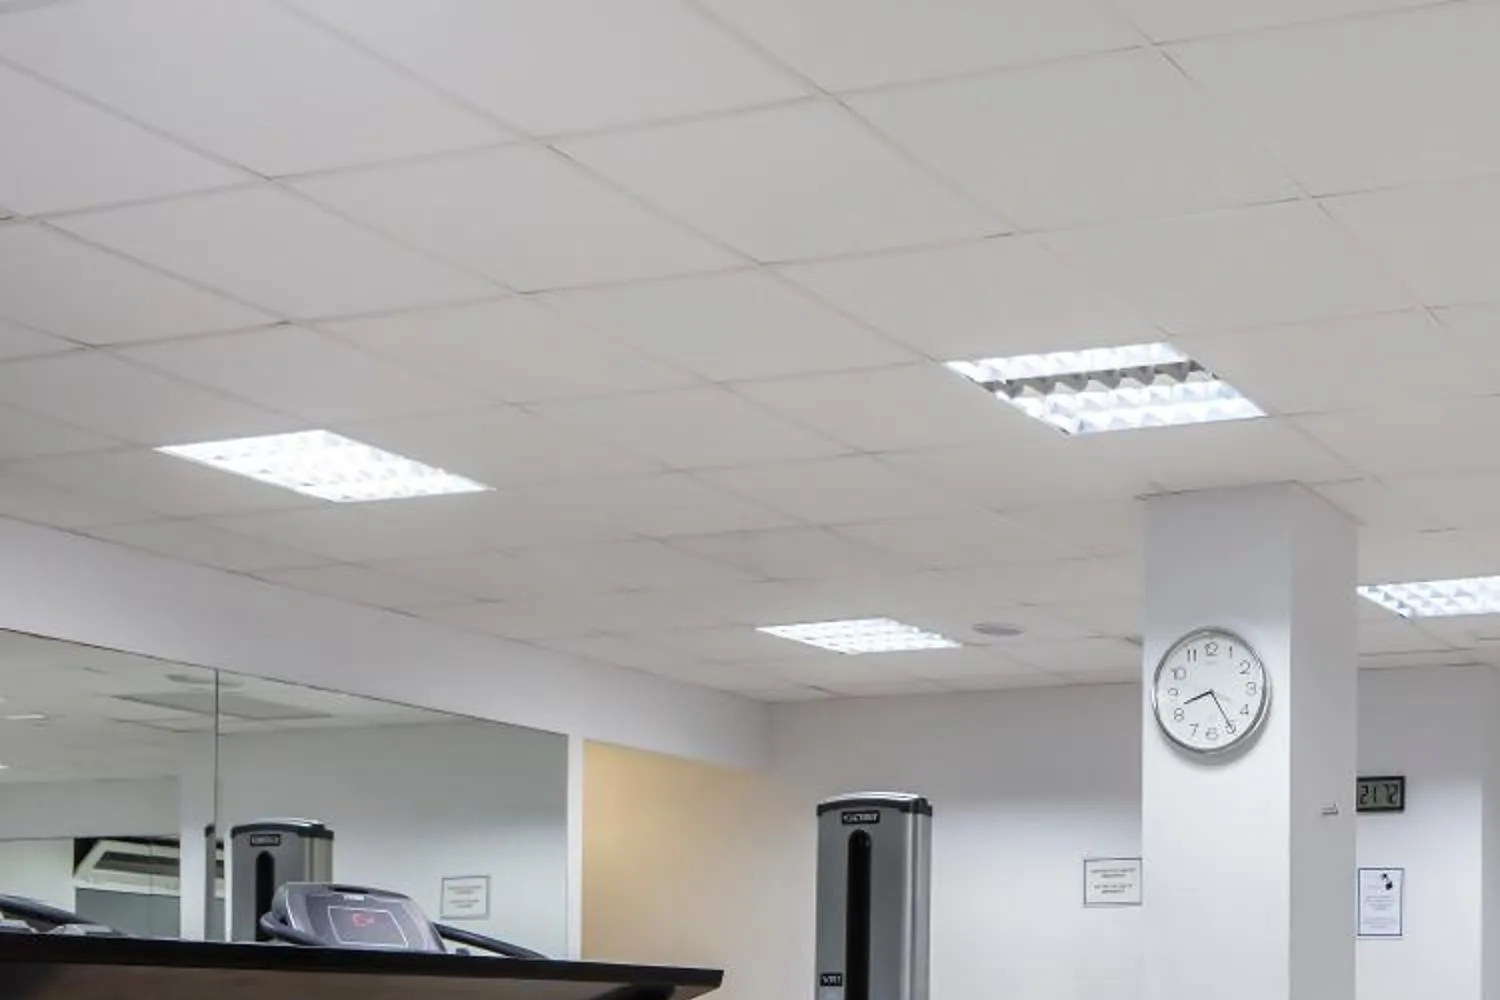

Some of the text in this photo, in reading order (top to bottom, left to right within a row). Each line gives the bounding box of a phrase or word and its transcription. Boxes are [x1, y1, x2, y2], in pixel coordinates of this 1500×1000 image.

[1186, 649, 1197, 662] 11
[1204, 641, 1219, 656] 12
[1171, 667, 1187, 681] 10
[1239, 659, 1251, 675] 2
[1167, 687, 1179, 699] 9
[1245, 681, 1257, 696] 3
[1173, 707, 1185, 722] 8
[1239, 703, 1249, 716] 4
[1189, 722, 1199, 736] 7
[1205, 727, 1218, 741] 6
